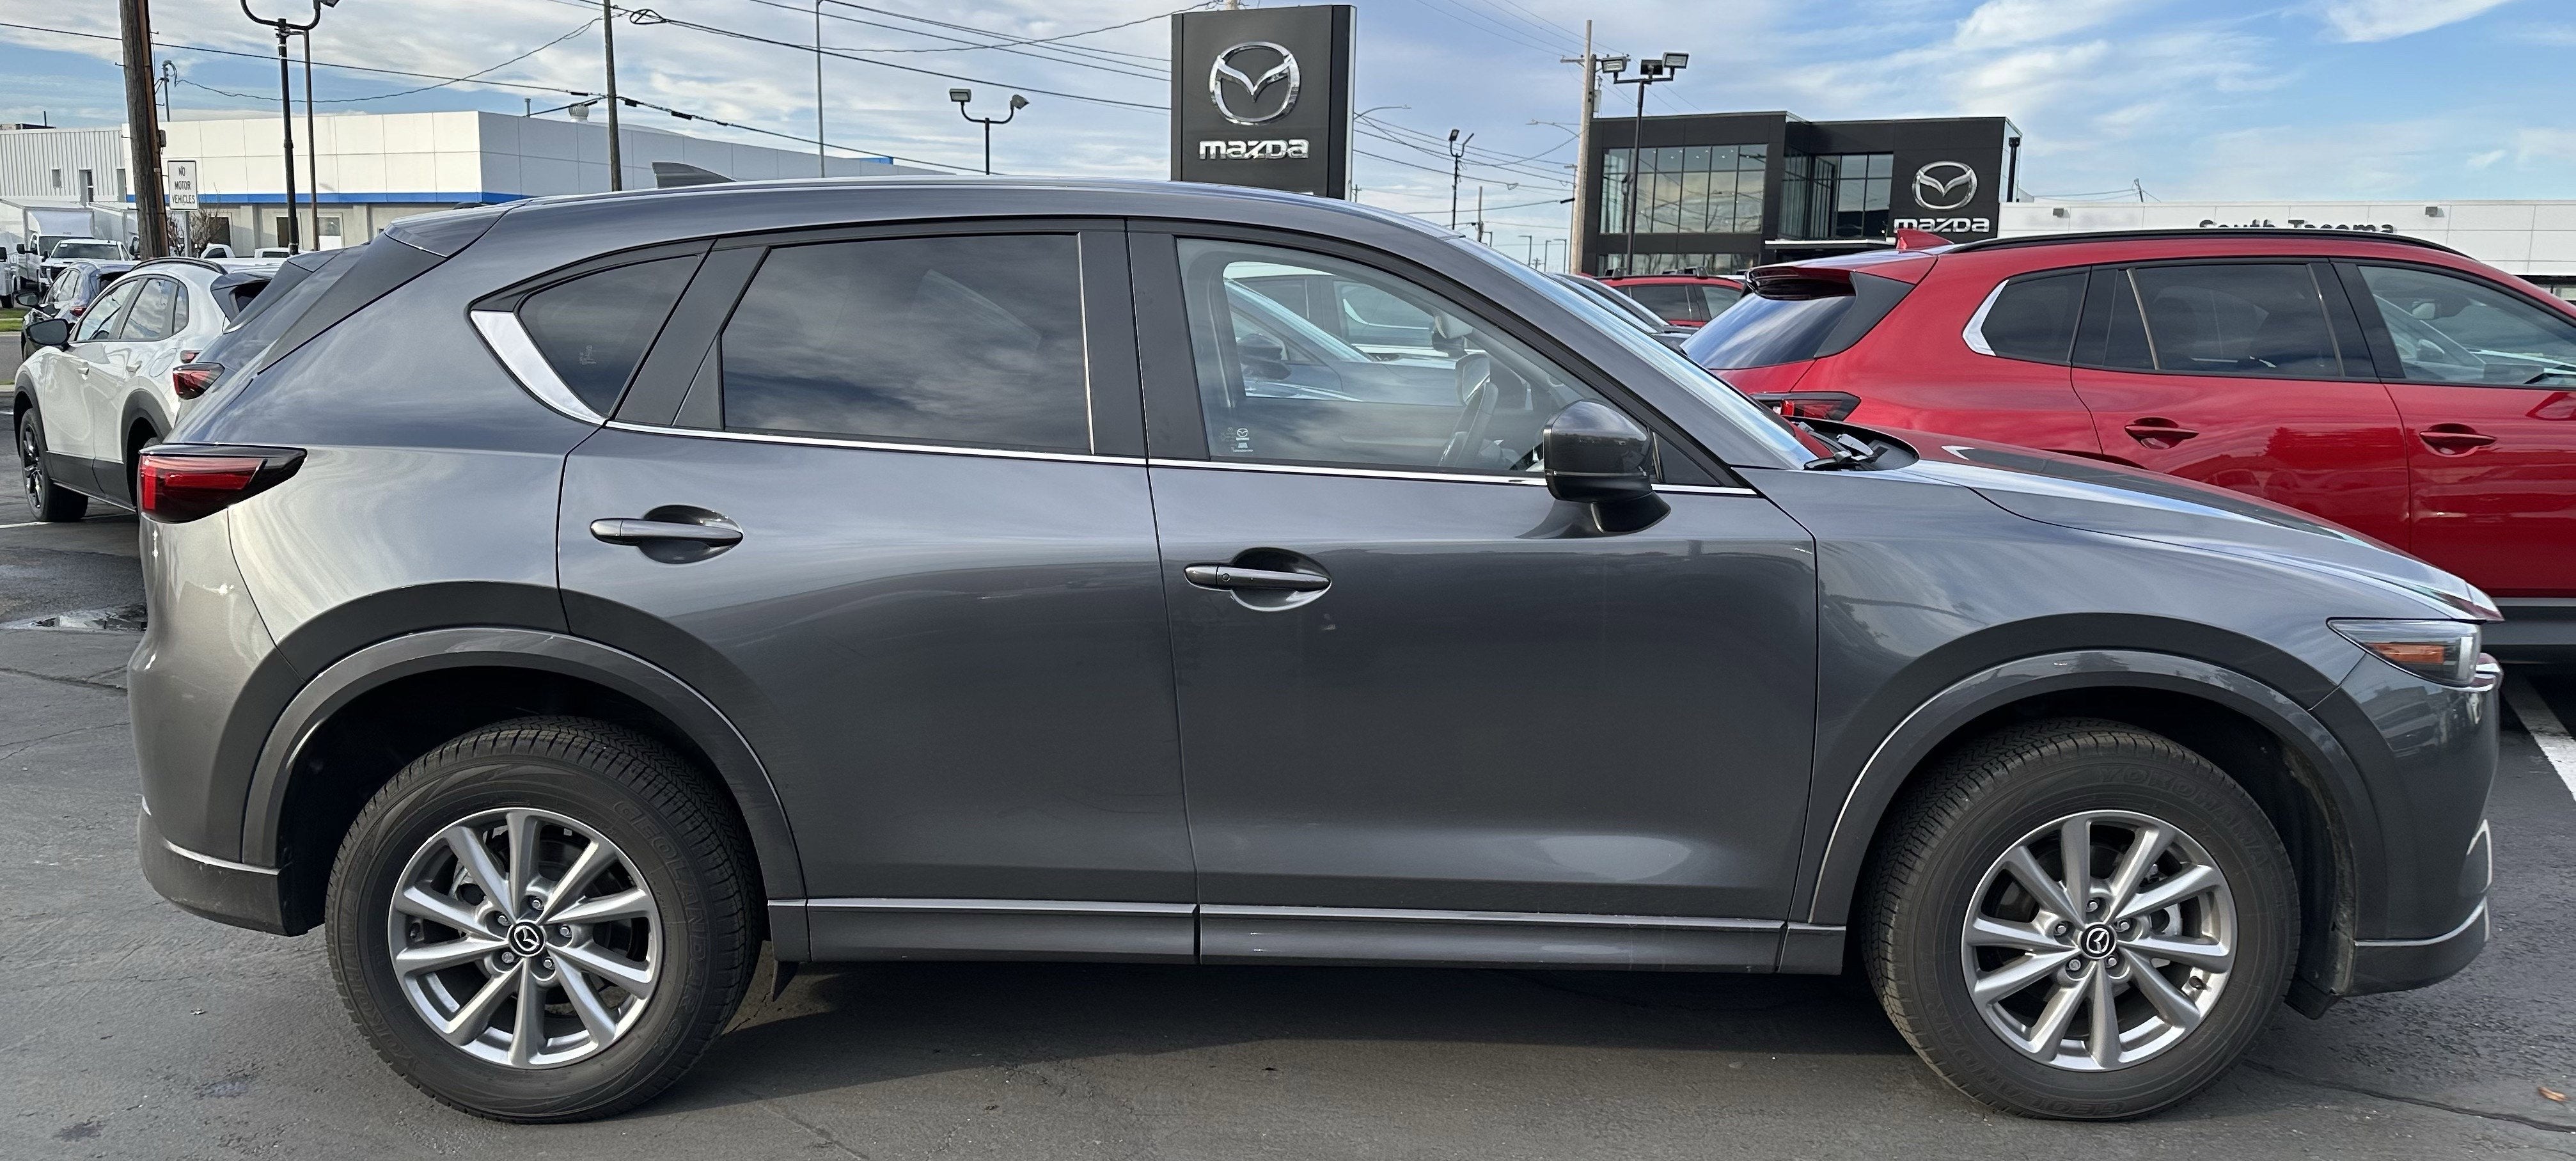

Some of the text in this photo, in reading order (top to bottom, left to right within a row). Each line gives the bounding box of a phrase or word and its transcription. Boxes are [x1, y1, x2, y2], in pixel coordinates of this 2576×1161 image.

[178, 166, 185, 176] NO
[175, 180, 191, 190] MOTOR
[172, 194, 196, 203] VEHICLES
[2097, 766, 2270, 867] YOKOHAMA
[613, 801, 705, 1014] GEOLANDAR
